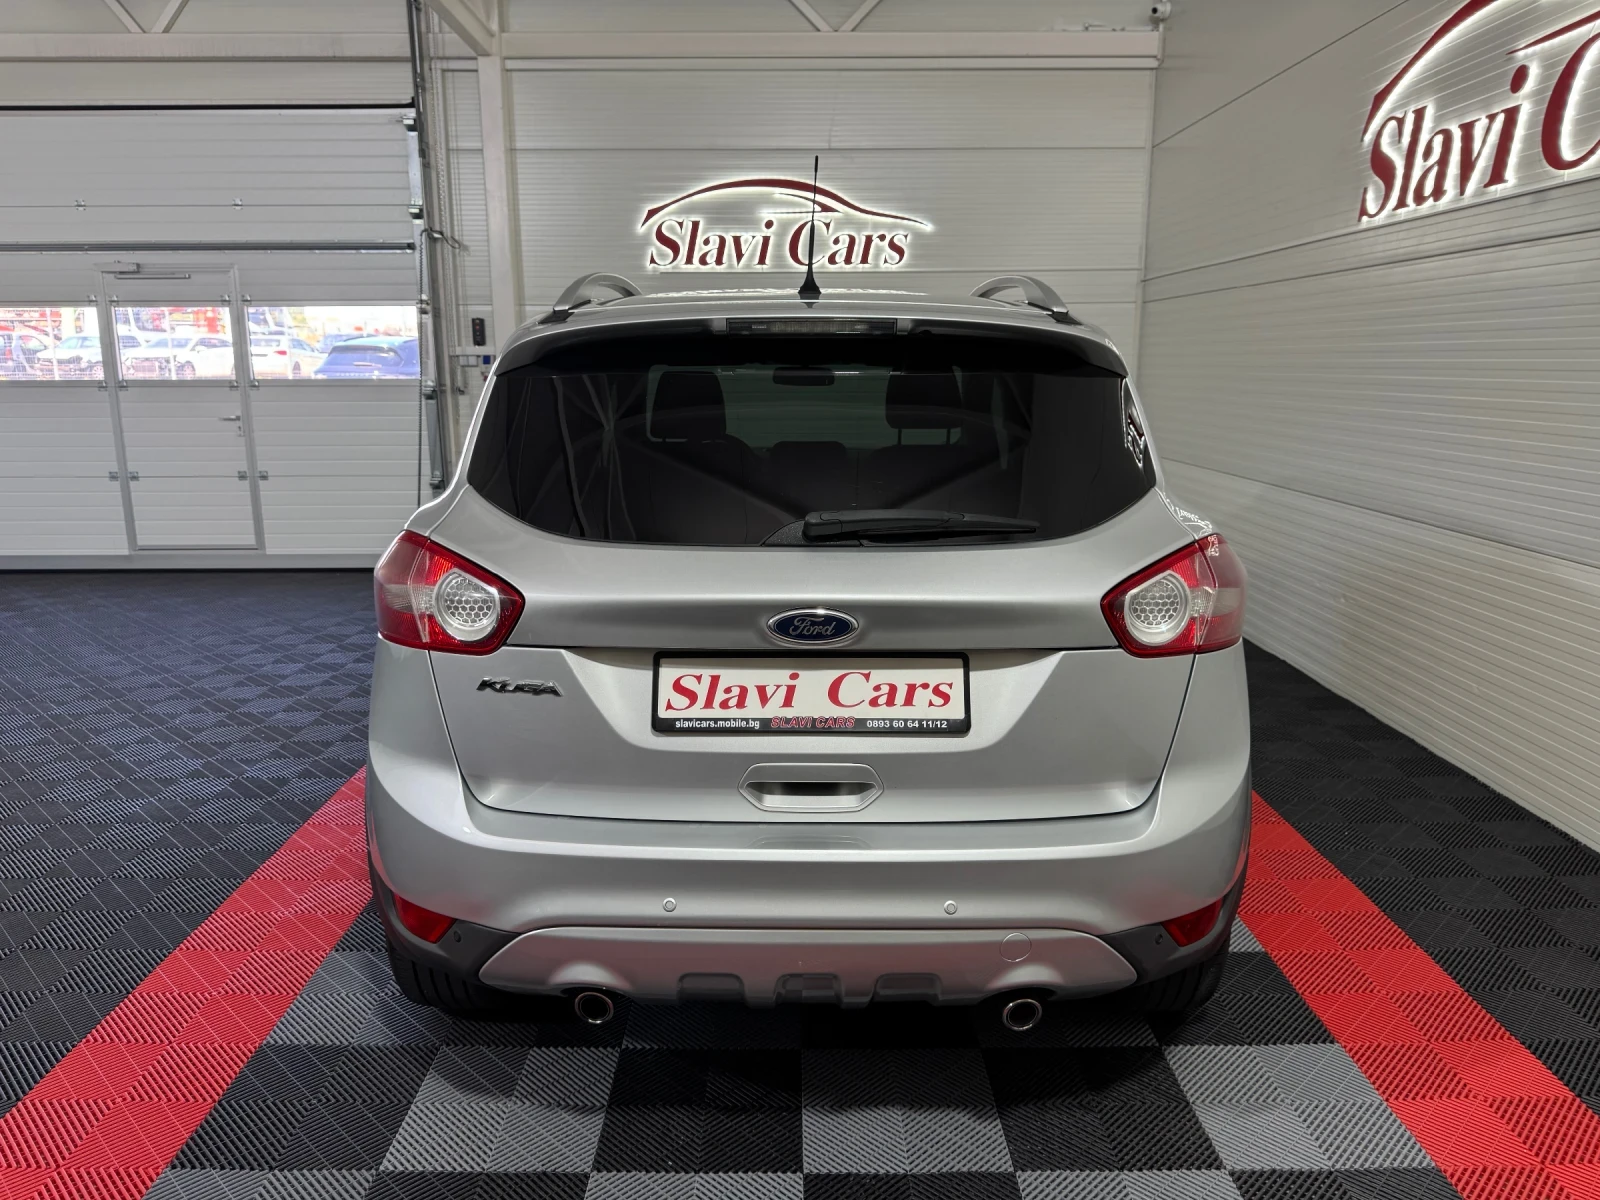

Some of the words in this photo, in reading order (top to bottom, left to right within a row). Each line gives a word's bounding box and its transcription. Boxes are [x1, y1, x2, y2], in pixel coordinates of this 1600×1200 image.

[1358, 64, 1530, 222] Slavi
[649, 219, 774, 267] Slavi
[788, 219, 909, 266] Cars
[789, 616, 837, 636] Ford
[476, 676, 564, 698] KUGA
[665, 672, 800, 711] Slavi
[827, 671, 953, 708] Cars
[675, 719, 760, 730] slavicars.mobile.bg
[770, 716, 812, 728] SLAVI
[815, 716, 856, 728] CARS
[866, 720, 891, 728] 0893
[892, 720, 906, 728] 60
[907, 720, 920, 728] 64
[921, 720, 948, 728] 11/12
